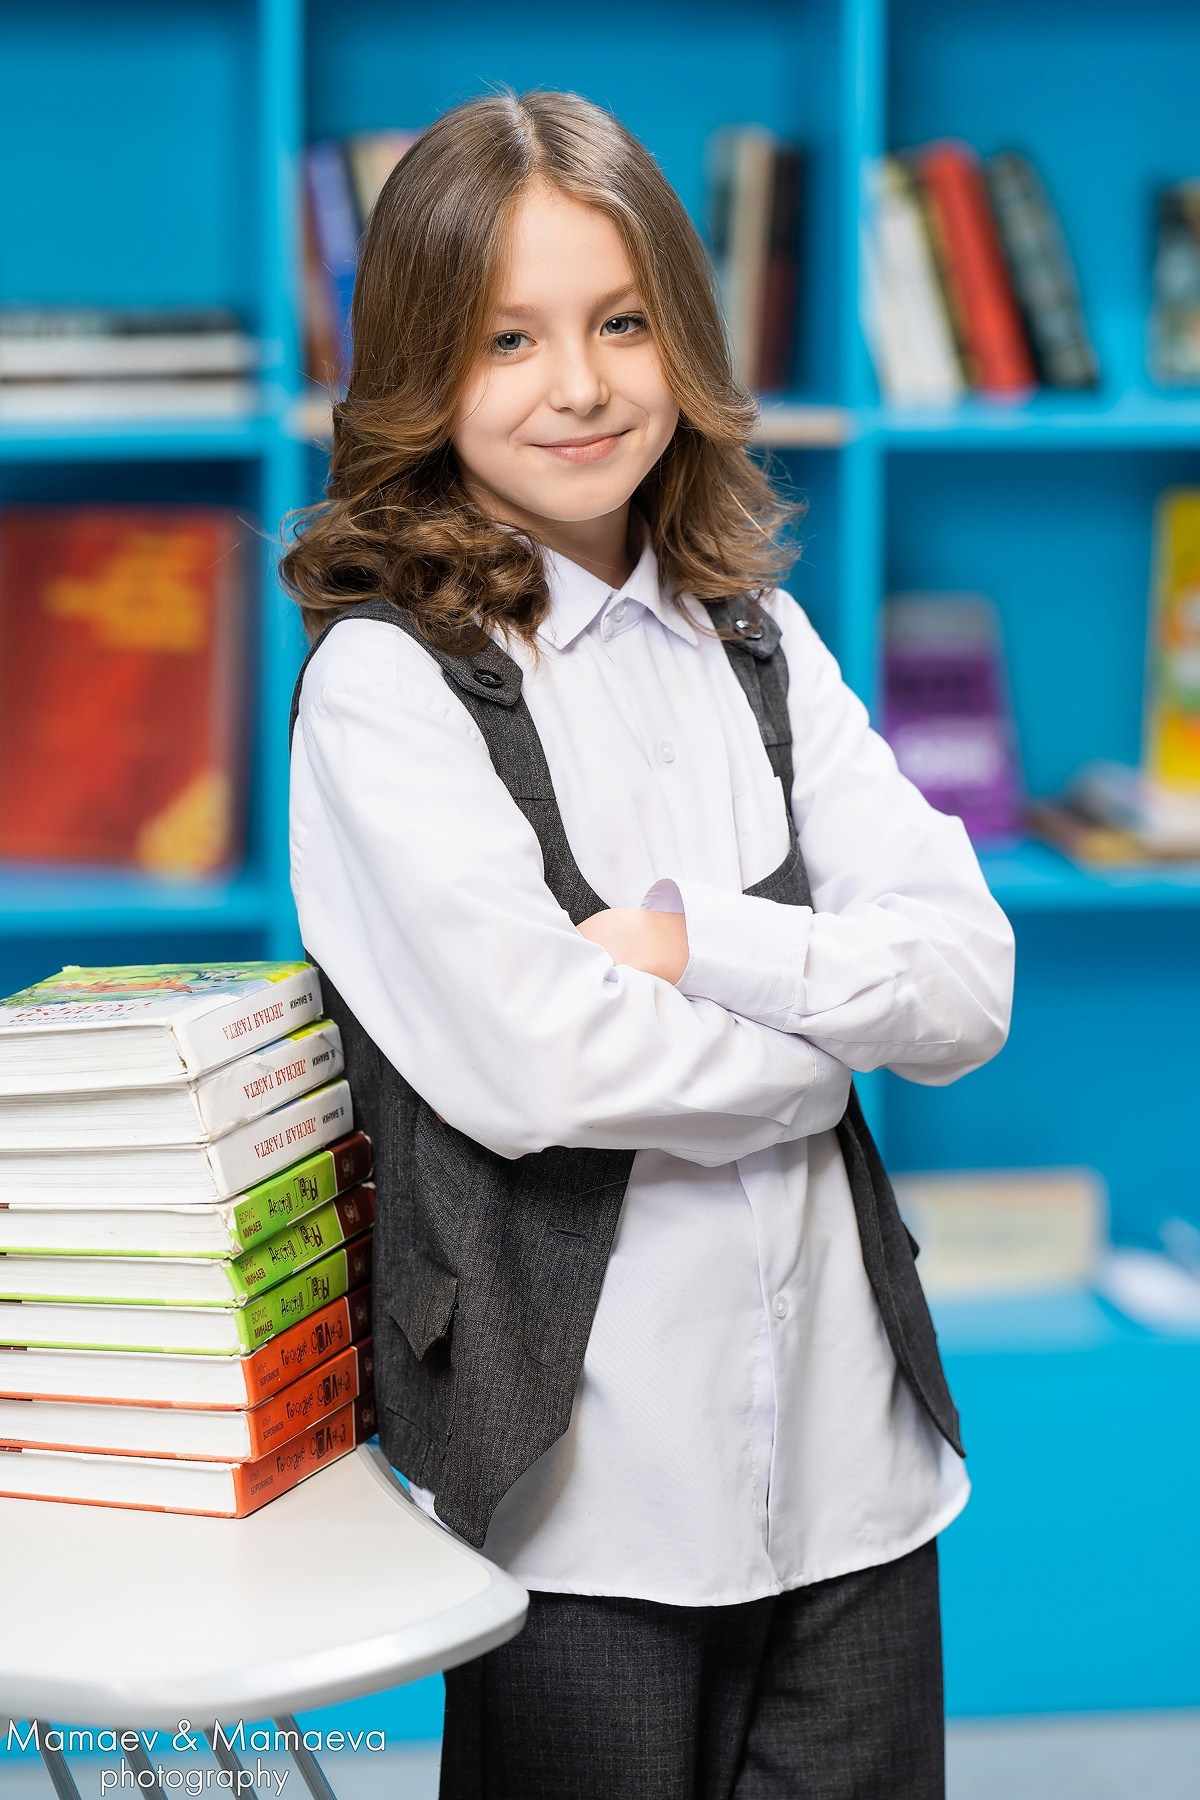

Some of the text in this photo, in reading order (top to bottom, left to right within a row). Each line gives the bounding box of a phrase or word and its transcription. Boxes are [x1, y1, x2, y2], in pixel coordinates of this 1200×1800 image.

[290, 994, 308, 1010] БИАНКИ
[222, 1002, 284, 1041] ЛЕСНАЯ ГАЗЕТА
[312, 1051, 331, 1067] БИАНКИ
[243, 1059, 306, 1100] ЛЕСНАЯ ГАЗЕТА
[321, 1110, 339, 1124] БИАНКИ
[254, 1116, 316, 1159] ЛЕСНАЯ ГАЗЕТА
[242, 1221, 263, 1239] МИНАЕВ
[244, 1268, 267, 1287] МИНАЕВ
[254, 1320, 274, 1337] МИНАЕВ
